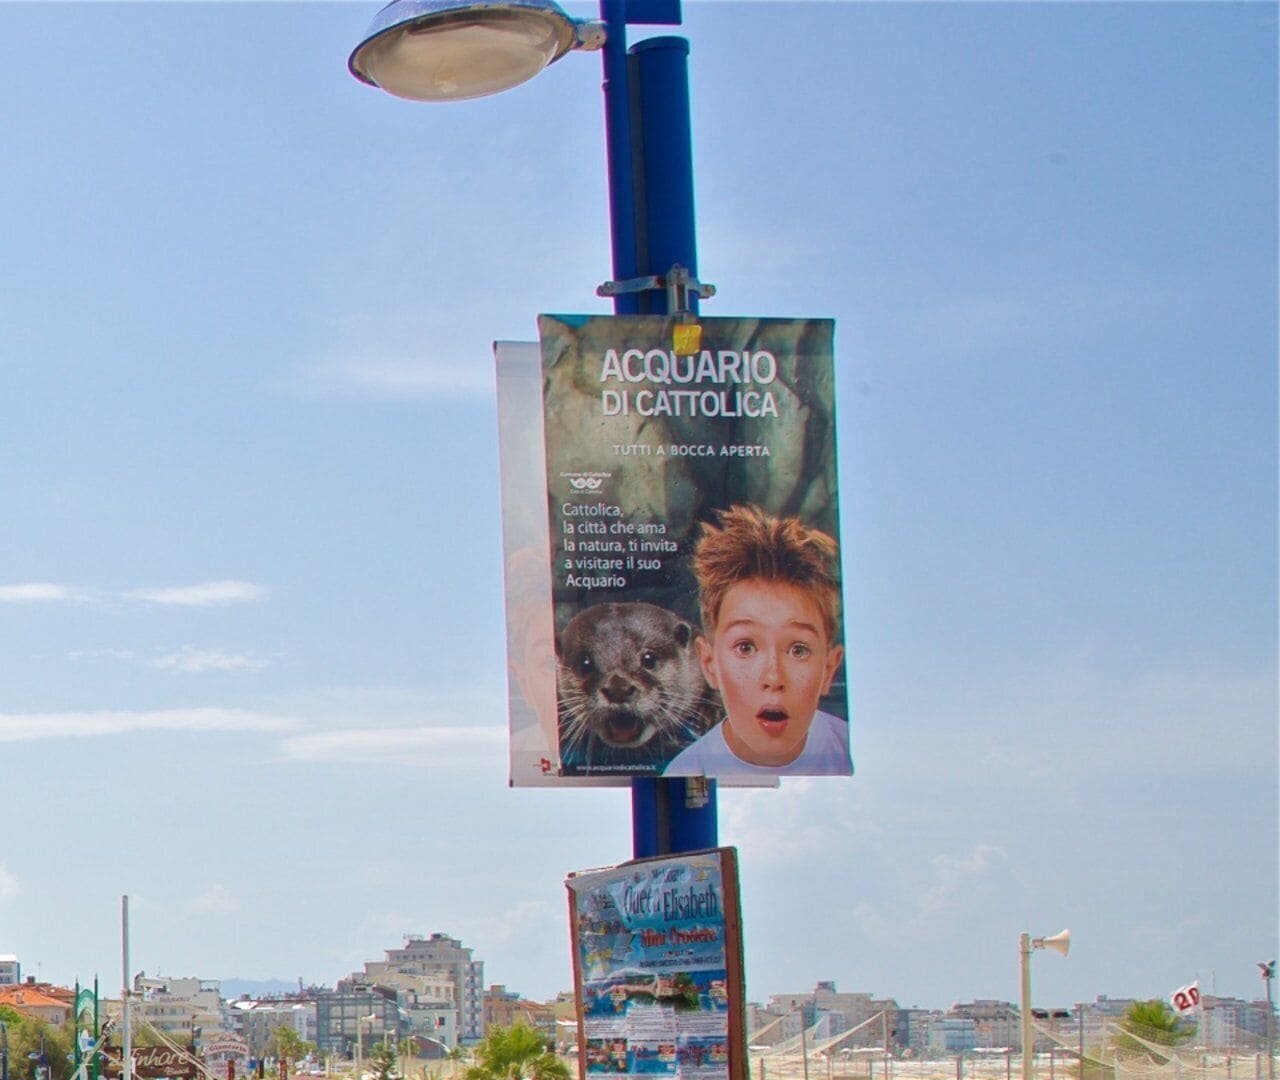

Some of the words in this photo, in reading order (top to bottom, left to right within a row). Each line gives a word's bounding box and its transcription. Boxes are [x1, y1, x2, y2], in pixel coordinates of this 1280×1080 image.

[600, 349, 777, 384] ACQUARIO
[602, 390, 629, 416] DI
[636, 390, 778, 418] CATTOLICA
[612, 444, 651, 456] TUTTI
[656, 445, 665, 456] A
[670, 445, 715, 456] BOCCA
[720, 446, 771, 457] APERTA
[562, 503, 625, 518] Cattolica,
[563, 521, 574, 534] la
[578, 521, 607, 534] città
[610, 521, 634, 534] che
[637, 524, 666, 534] ama
[564, 539, 575, 552] la
[580, 541, 626, 554] natura,
[629, 540, 638, 552] ti
[641, 539, 678, 552] invita
[565, 559, 572, 569] a
[576, 557, 623, 569] visitare
[626, 557, 634, 569] il
[637, 559, 661, 569] suo
[566, 574, 626, 590] Acquario
[663, 884, 718, 921] Elisabeth
